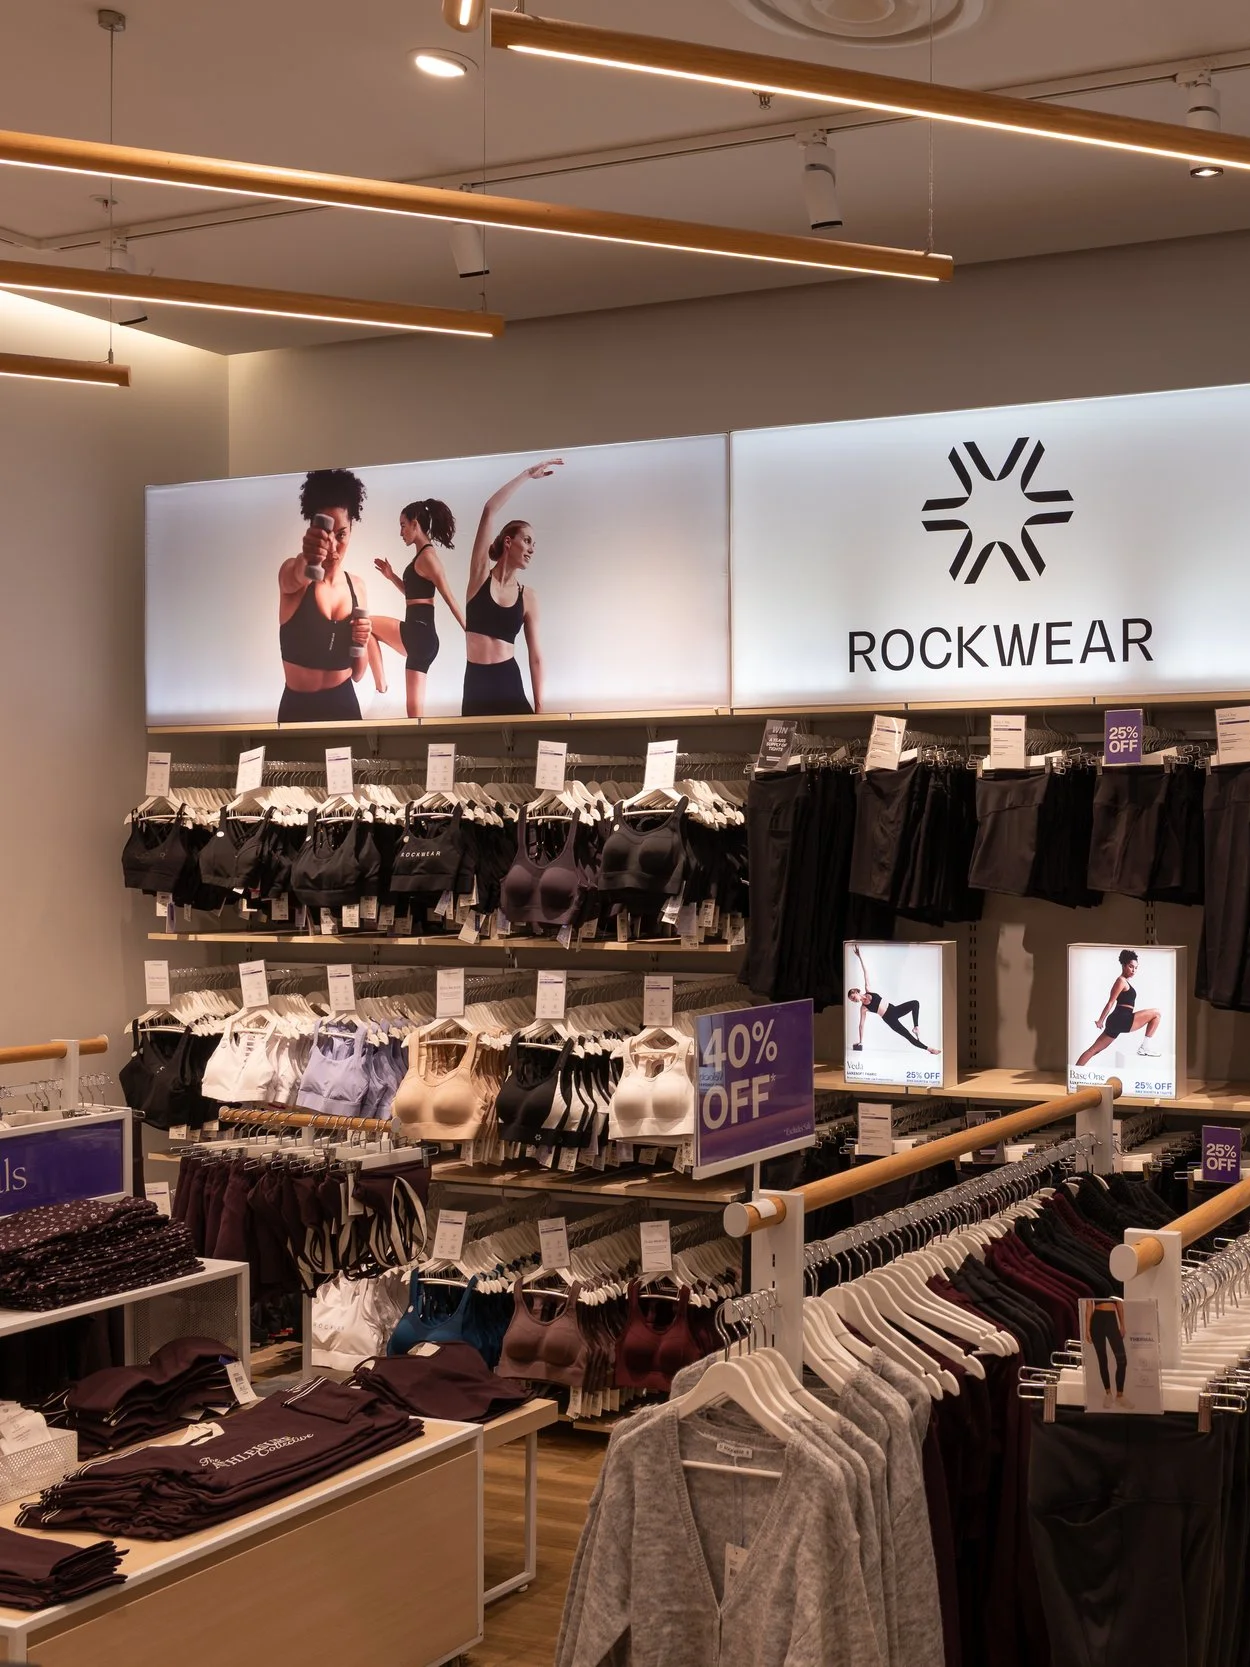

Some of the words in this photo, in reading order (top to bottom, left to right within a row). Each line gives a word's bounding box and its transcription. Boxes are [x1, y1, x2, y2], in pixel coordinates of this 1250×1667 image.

[848, 618, 1154, 673] ROCKWEAR
[1108, 726, 1139, 740] 25%
[1108, 739, 1138, 753] OFF
[703, 1019, 778, 1073] 40%
[847, 1061, 864, 1070] Veda
[906, 1071, 922, 1080] 25%
[924, 1072, 940, 1080] OFF
[1070, 1070, 1086, 1080] Base
[1089, 1071, 1105, 1081] One
[1135, 1081, 1152, 1090] 25%
[1154, 1082, 1172, 1090] OFF
[1206, 1143, 1237, 1158] 25%
[1206, 1157, 1237, 1171] OFF
[0, 1157, 27, 1194] ls
